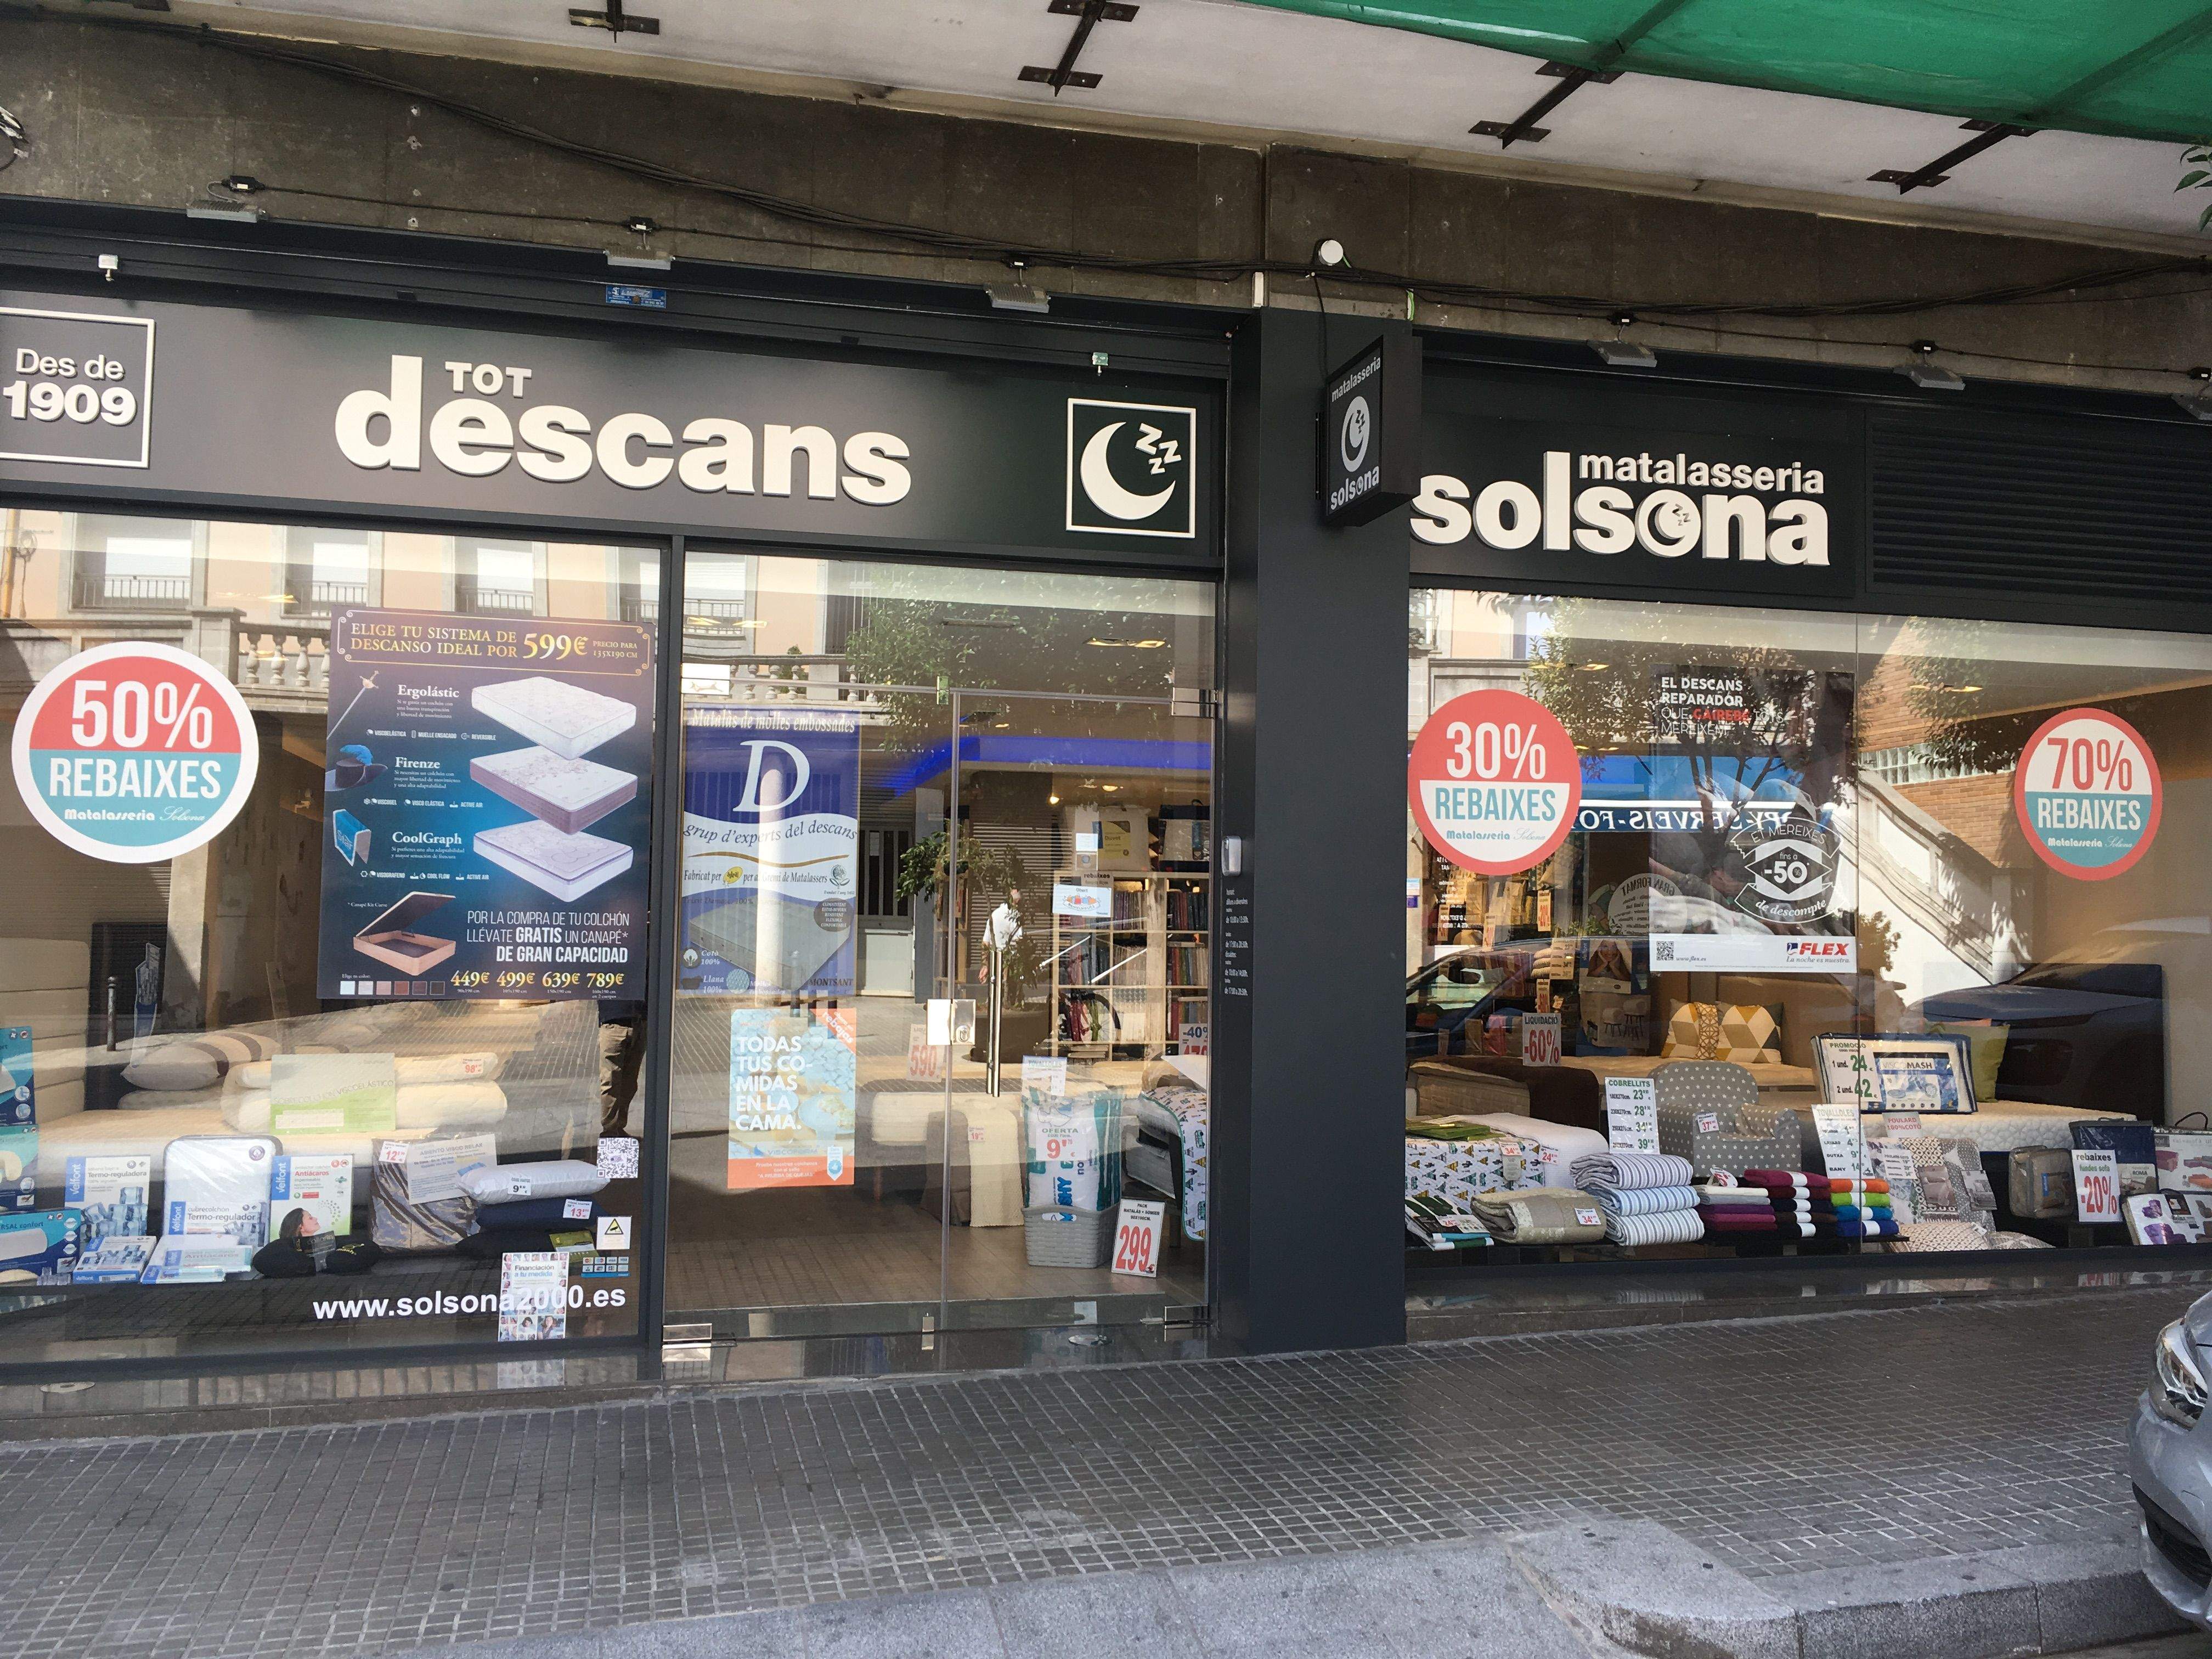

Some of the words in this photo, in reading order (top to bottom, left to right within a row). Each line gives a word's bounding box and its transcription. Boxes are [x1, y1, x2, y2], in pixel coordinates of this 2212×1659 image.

[15, 348, 77, 377] Des
[84, 354, 125, 380] de
[445, 361, 532, 397] TOT
[1331, 357, 1381, 402] matalasseria
[2, 380, 138, 426] 1909
[335, 354, 912, 506] descans
[1578, 452, 1825, 495] matalasseria
[1330, 466, 1380, 510] solsona
[1410, 451, 1831, 567] solsona
[351, 623, 396, 636] ELIGE
[401, 625, 422, 638] TU
[427, 627, 491, 642] SISTEMA
[496, 630, 517, 643] DE
[351, 637, 432, 653] DESCANSO
[437, 641, 482, 656] IDEAL
[487, 645, 518, 658] POR
[522, 633, 589, 660] 599€
[592, 640, 618, 648] PRECIO
[397, 684, 460, 699] Ergolástic
[1662, 676, 1677, 689] EL
[1681, 678, 1743, 692] DESCANS
[1661, 692, 1743, 707] REPARADOR
[72, 679, 213, 749] 50%
[741, 710, 752, 729] de
[755, 710, 790, 730] molles
[793, 714, 855, 733] embossades
[1661, 707, 1689, 720] QUE
[1661, 723, 1727, 735] MEREIXEM
[1446, 721, 1545, 780] 30%
[394, 757, 441, 769] Firenze
[2047, 737, 2132, 791] 70%
[49, 757, 221, 799] REBAIXES
[733, 740, 810, 812] D
[1435, 787, 1556, 822] REBAIXES
[64, 808, 155, 821] Matalasseria
[2038, 798, 2141, 831] REBAIXES
[392, 832, 462, 848] CoolGraph
[682, 824, 718, 844] grup
[785, 821, 804, 839] del
[808, 819, 857, 840] descans
[1446, 830, 1510, 840] Matalasseria
[1751, 828, 1765, 843] ET
[1768, 824, 1827, 844] MEREIXES
[2047, 837, 2103, 848] Matalasseria
[684, 870, 710, 881] Fabricat
[712, 872, 722, 883] per
[743, 873, 754, 884] per
[782, 872, 789, 883] de
[790, 872, 828, 883] Matalassers
[1756, 900, 1769, 912] de
[1770, 899, 1827, 917] descompte
[467, 911, 488, 924] POR
[490, 911, 504, 924] LA
[507, 911, 549, 925] COMPRA
[552, 912, 566, 925] DE
[569, 912, 582, 926] TU
[584, 910, 630, 926] COLCHÓN
[466, 927, 512, 943] LLÉVATE
[516, 927, 562, 943] GRATIS
[565, 930, 579, 943] UN
[496, 946, 514, 962] DE
[517, 946, 552, 962] GRAN
[555, 947, 628, 963] CAPACIDAD
[1799, 943, 1850, 956] FLEX
[450, 970, 490, 987] 449€
[496, 970, 536, 988] 499€
[542, 971, 580, 988] 639€
[586, 972, 624, 988] 789€
[809, 978, 854, 987] MONTSANT
[822, 1011, 854, 1043] rebajas
[736, 1036, 802, 1053] TODAS
[1524, 1029, 1559, 1064] -60%
[736, 1056, 772, 1072] TUS
[777, 1056, 812, 1072] CO-
[736, 1075, 798, 1092] MIDAS
[736, 1095, 761, 1111] EN
[766, 1094, 791, 1111] LA
[735, 1114, 802, 1131] CAMA.
[2076, 1153, 2112, 1161] rebaixes
[2081, 1176, 2118, 1215] -20%
[187, 1213, 256, 1222] Termo-regulador
[1115, 1225, 1151, 1272] 299
[313, 1285, 627, 1319] www.solsona2000.es
